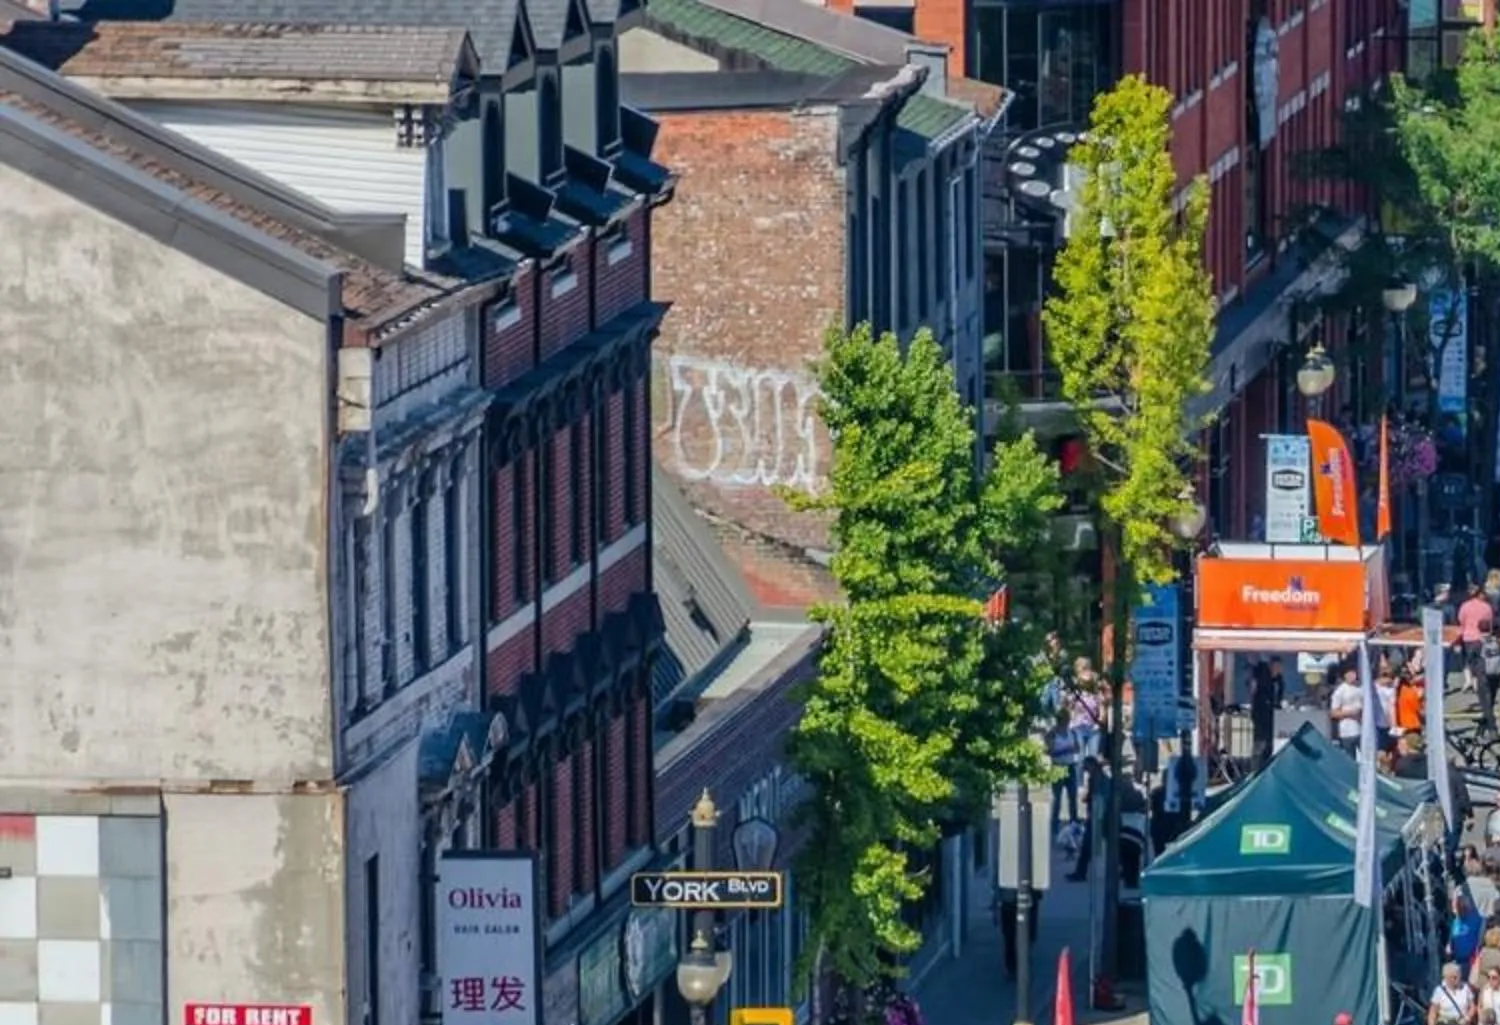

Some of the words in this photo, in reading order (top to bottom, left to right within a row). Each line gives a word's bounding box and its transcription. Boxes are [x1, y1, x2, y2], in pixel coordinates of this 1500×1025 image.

[1242, 584, 1321, 604] Freedom
[1247, 829, 1284, 848] TD
[448, 887, 522, 910] Olivia
[644, 878, 721, 901] YORK
[727, 878, 769, 893] BLVD
[450, 975, 526, 1012] 理发
